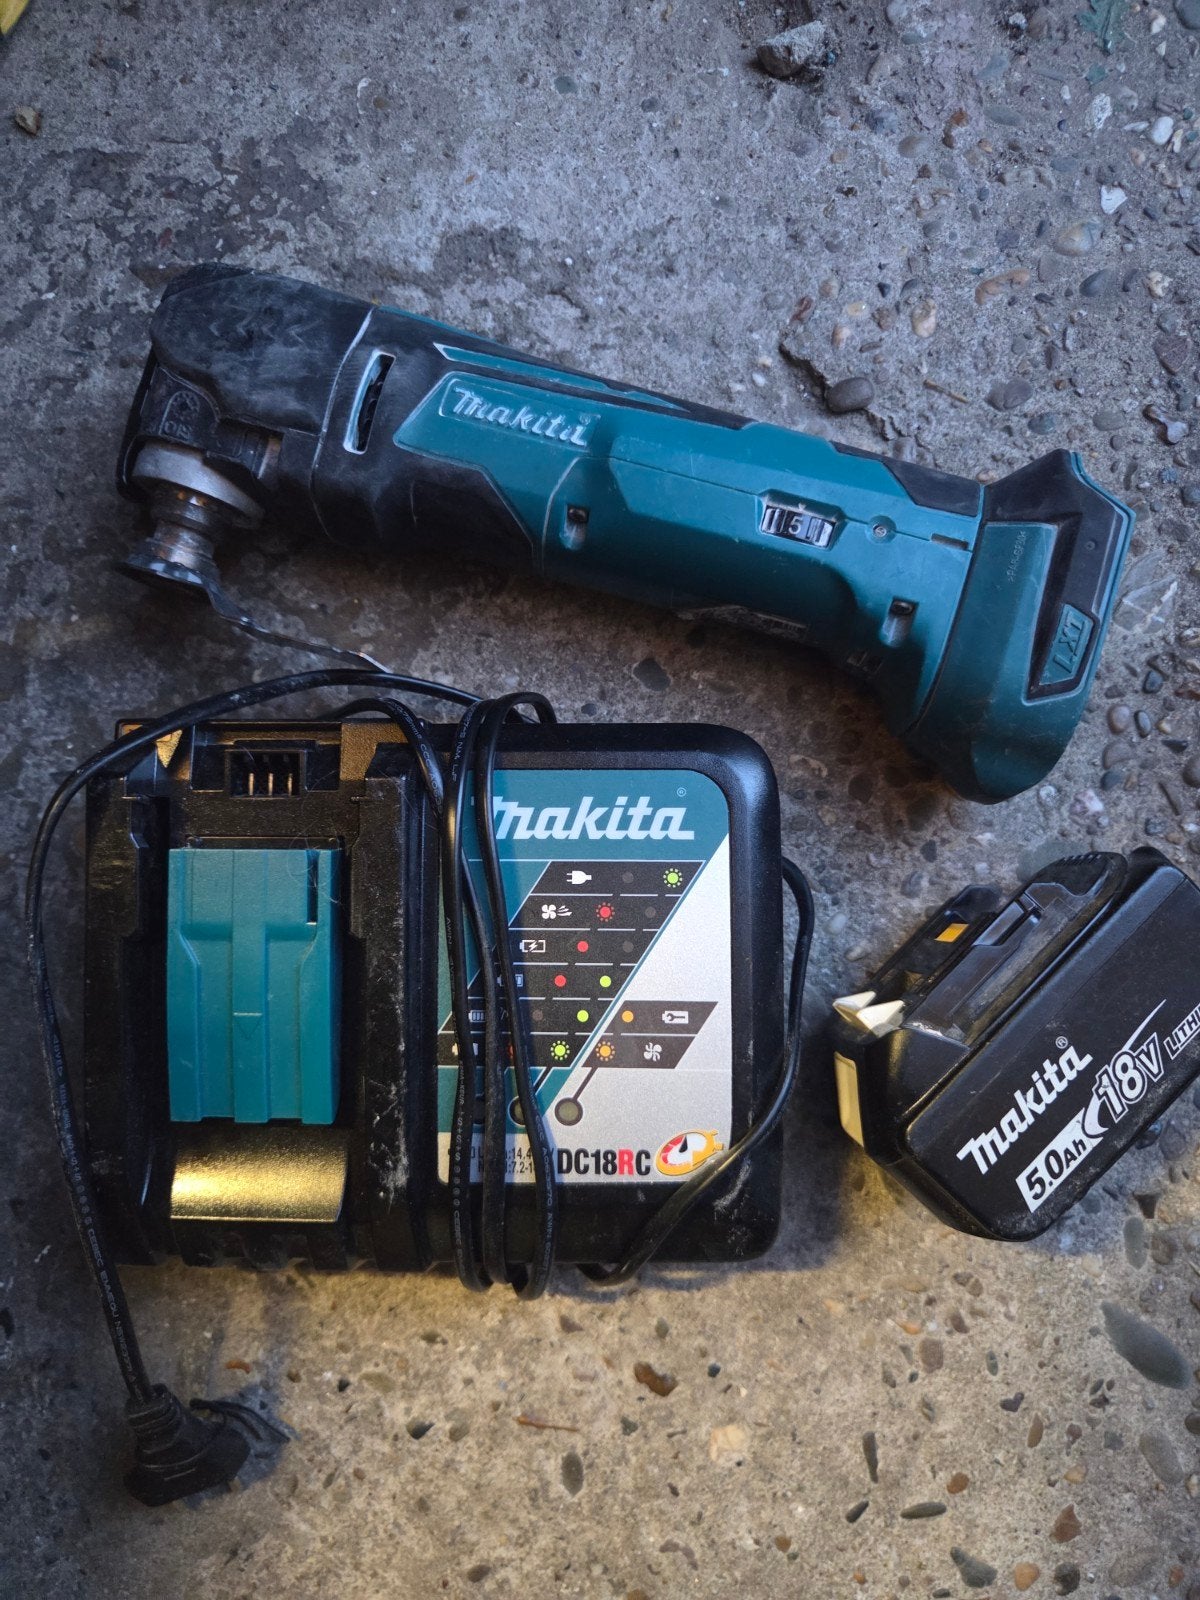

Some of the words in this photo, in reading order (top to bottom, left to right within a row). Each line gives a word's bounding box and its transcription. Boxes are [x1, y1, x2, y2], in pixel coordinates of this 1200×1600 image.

[788, 516, 803, 535] 5
[1053, 618, 1085, 674] LXT
[1091, 1031, 1165, 1124] 18V
[557, 1147, 651, 1176] DC18RC
[1025, 1138, 1088, 1202] 5.0Ah
